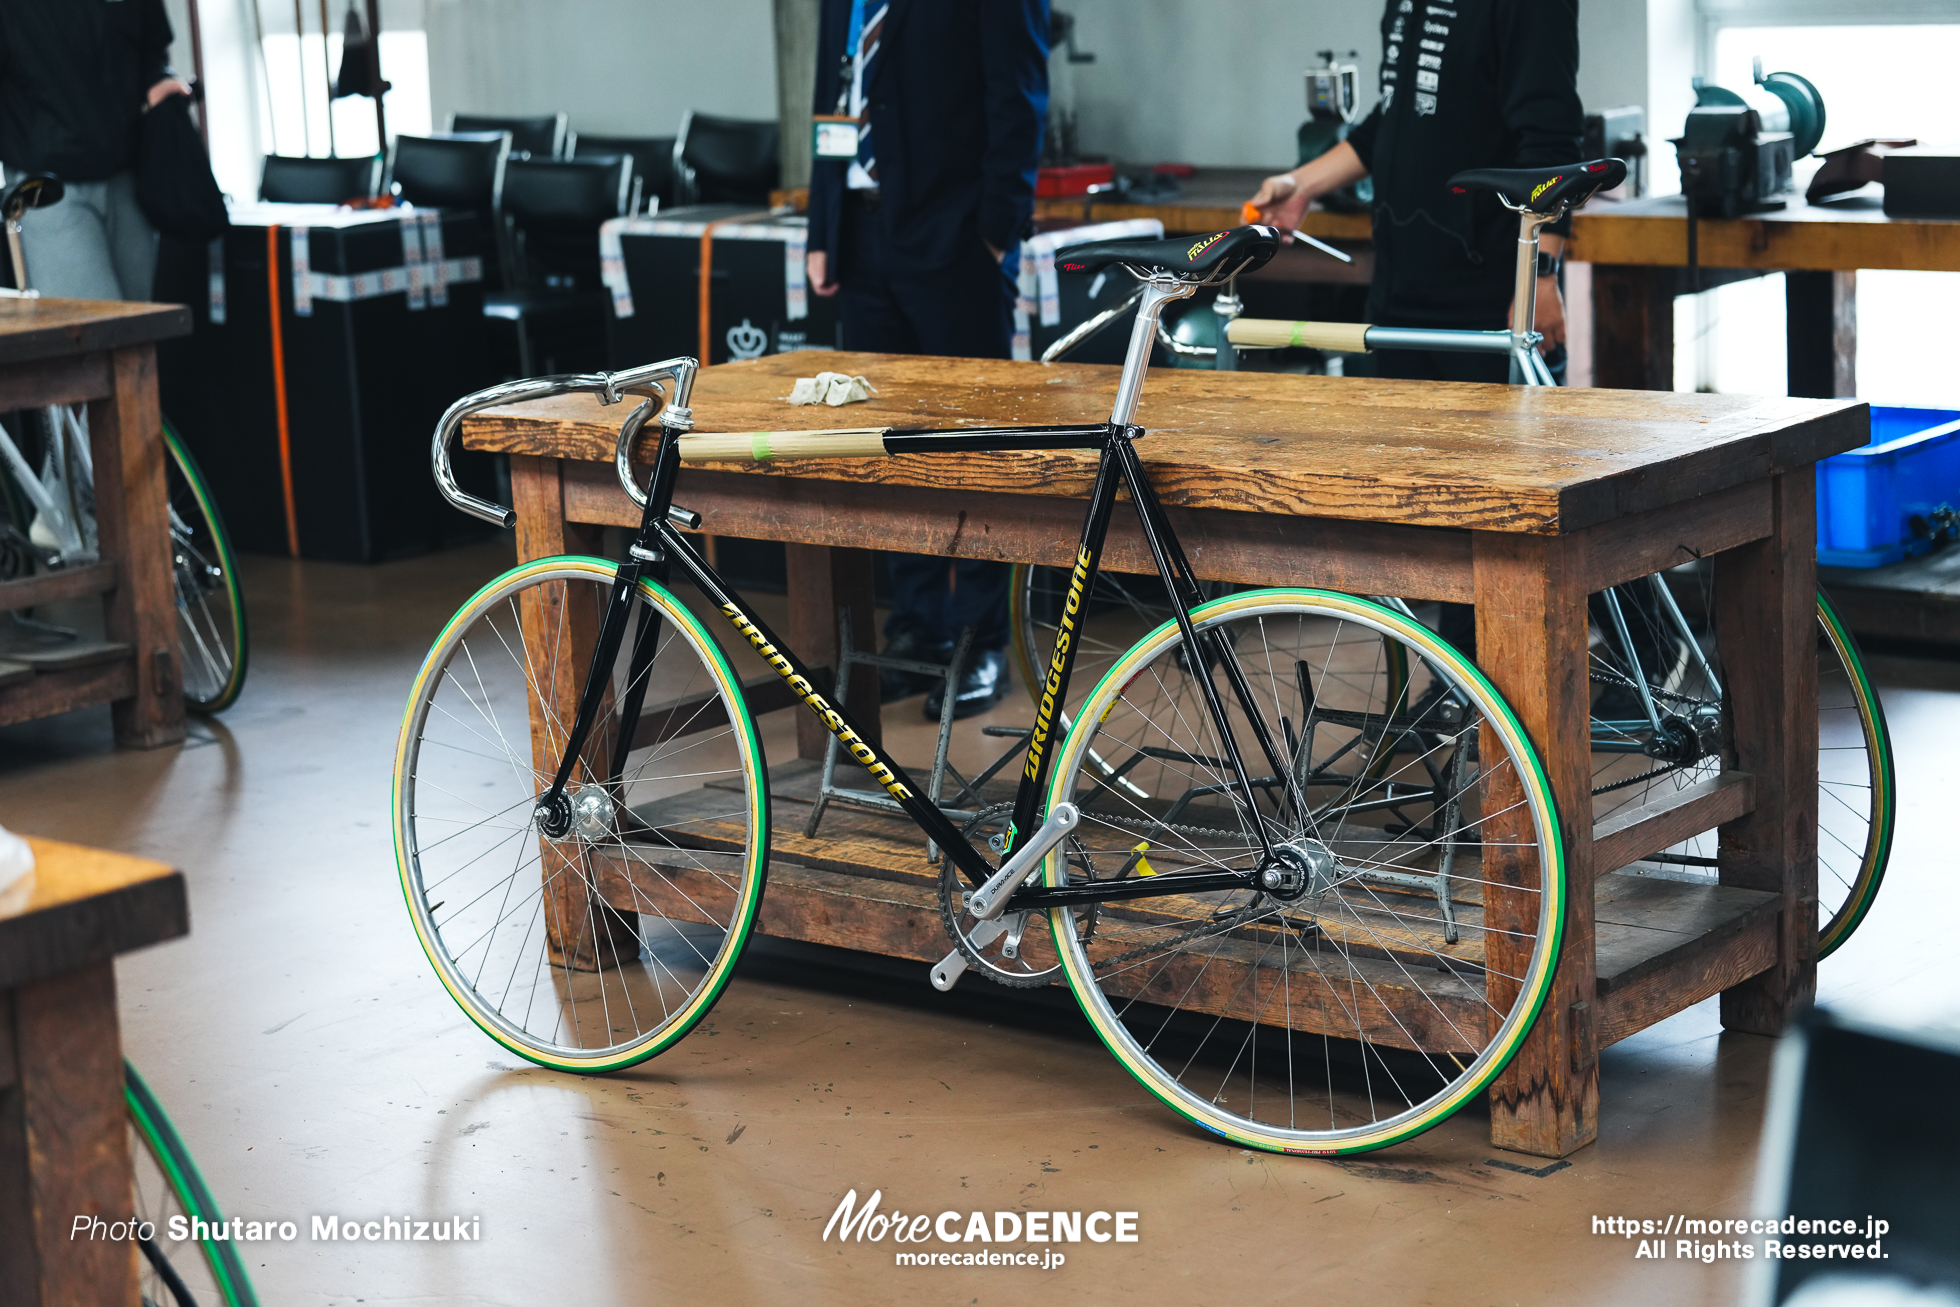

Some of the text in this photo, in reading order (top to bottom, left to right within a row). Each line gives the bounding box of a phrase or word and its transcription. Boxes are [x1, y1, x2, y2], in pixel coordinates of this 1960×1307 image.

[1063, 263, 1086, 272] Flite
[719, 602, 914, 803] BRIDGESTONE
[1025, 542, 1092, 783] BRIDGESTONE
